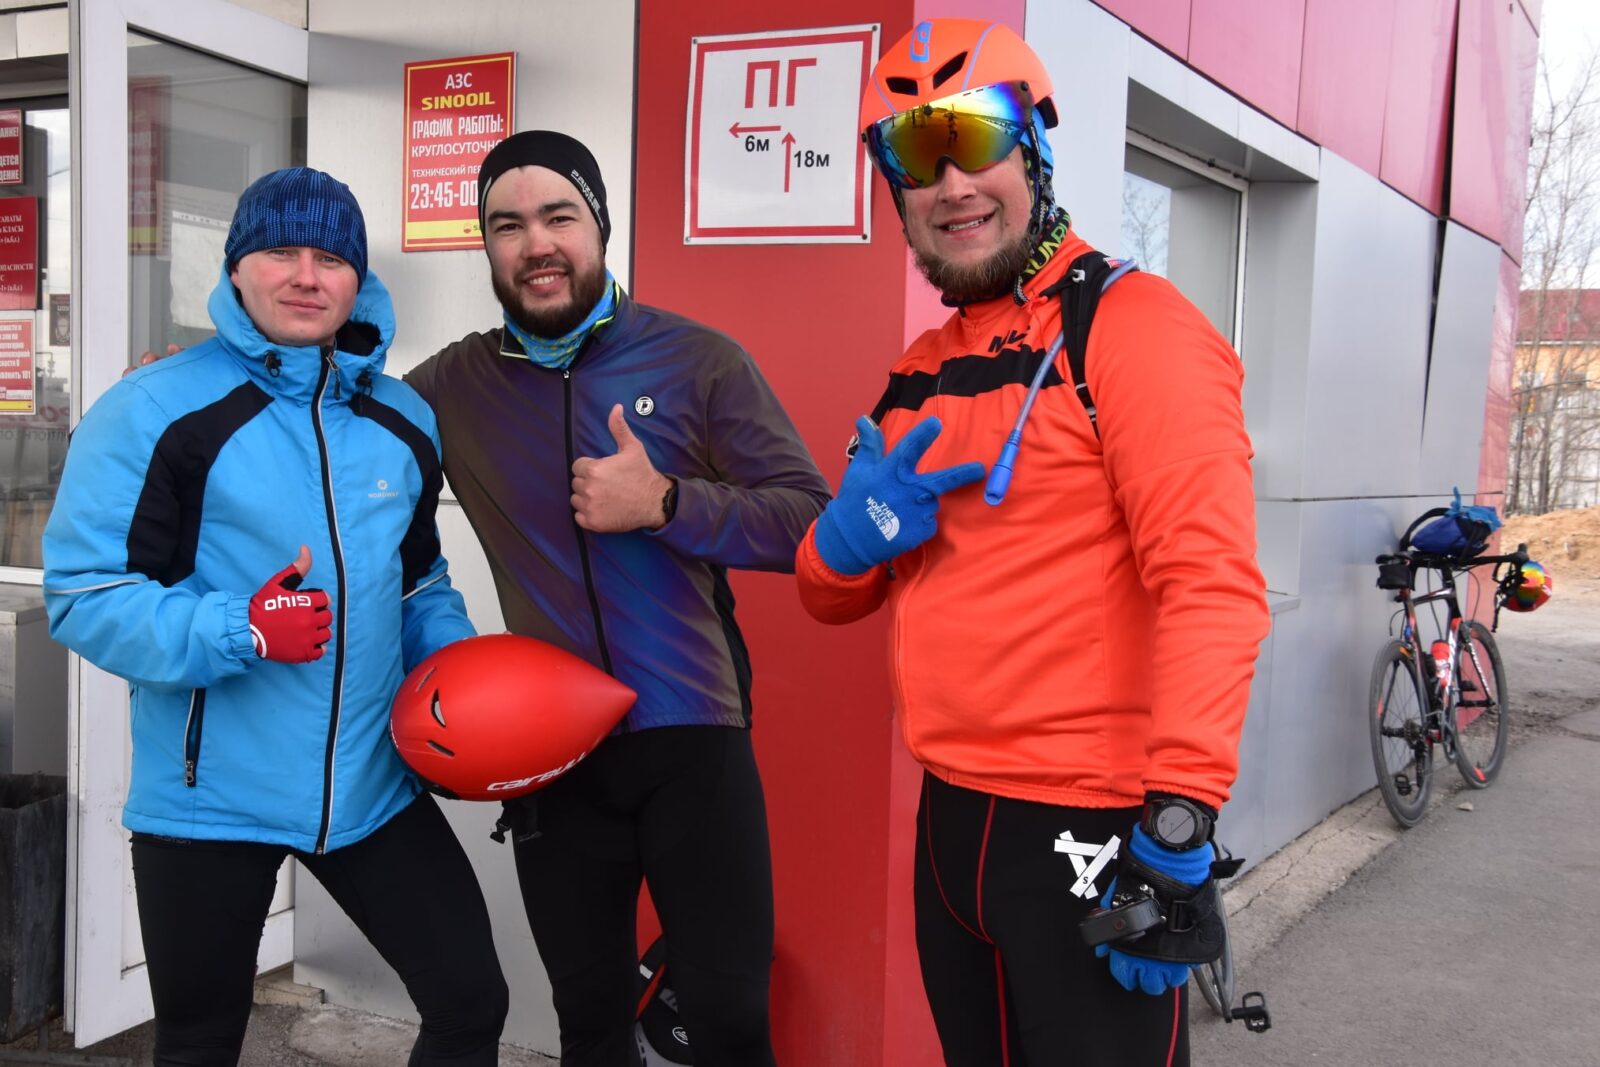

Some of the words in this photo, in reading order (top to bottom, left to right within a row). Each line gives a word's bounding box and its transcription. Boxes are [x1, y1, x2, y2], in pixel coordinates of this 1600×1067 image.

[445, 73, 472, 90] АЗС
[745, 57, 817, 108] ПГ
[421, 92, 495, 111] SINOOIL
[412, 118, 453, 139] ГРАФИК
[458, 113, 504, 135] РАБОТЫ:
[412, 165, 465, 178] ТЕХНИЧЕСКИЙ
[866, 496, 890, 524] NORTH
[866, 507, 884, 528] FACE
[880, 502, 895, 519] THE
